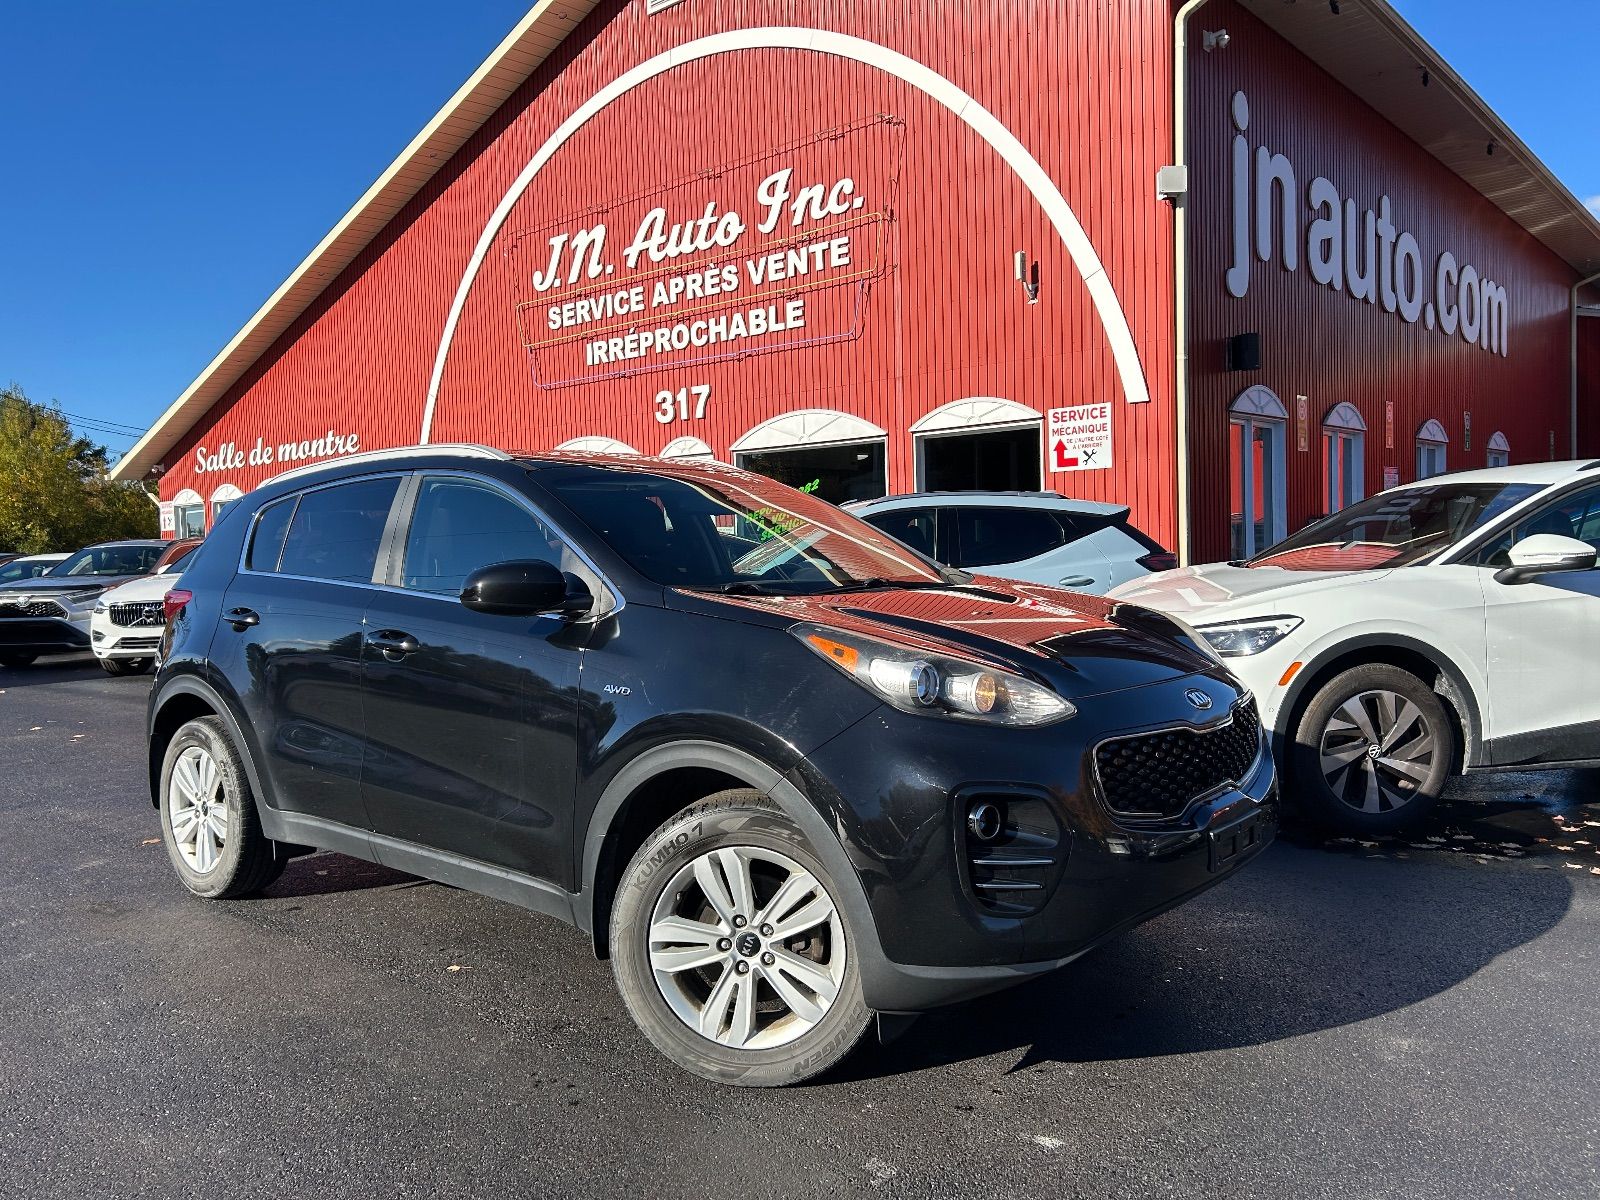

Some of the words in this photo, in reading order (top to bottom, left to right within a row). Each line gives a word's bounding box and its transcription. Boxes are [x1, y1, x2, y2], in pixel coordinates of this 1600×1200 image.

[533, 224, 614, 292] J.N.
[623, 202, 746, 269] Auto
[757, 168, 865, 234] Inc.
[548, 286, 645, 330] SERVICE
[652, 263, 739, 308] APRÈS
[746, 236, 850, 285] VENTE
[586, 300, 805, 366] IRRÉPROCHABLE
[655, 385, 711, 424] 317
[1052, 406, 1107, 424] SERVICE
[195, 442, 246, 474] Salle
[249, 437, 274, 467] de
[278, 429, 361, 463] montre
[1052, 422, 1108, 437] MÉCANIQUE
[603, 684, 631, 696] AWD
[632, 832, 689, 893] KUMHO
